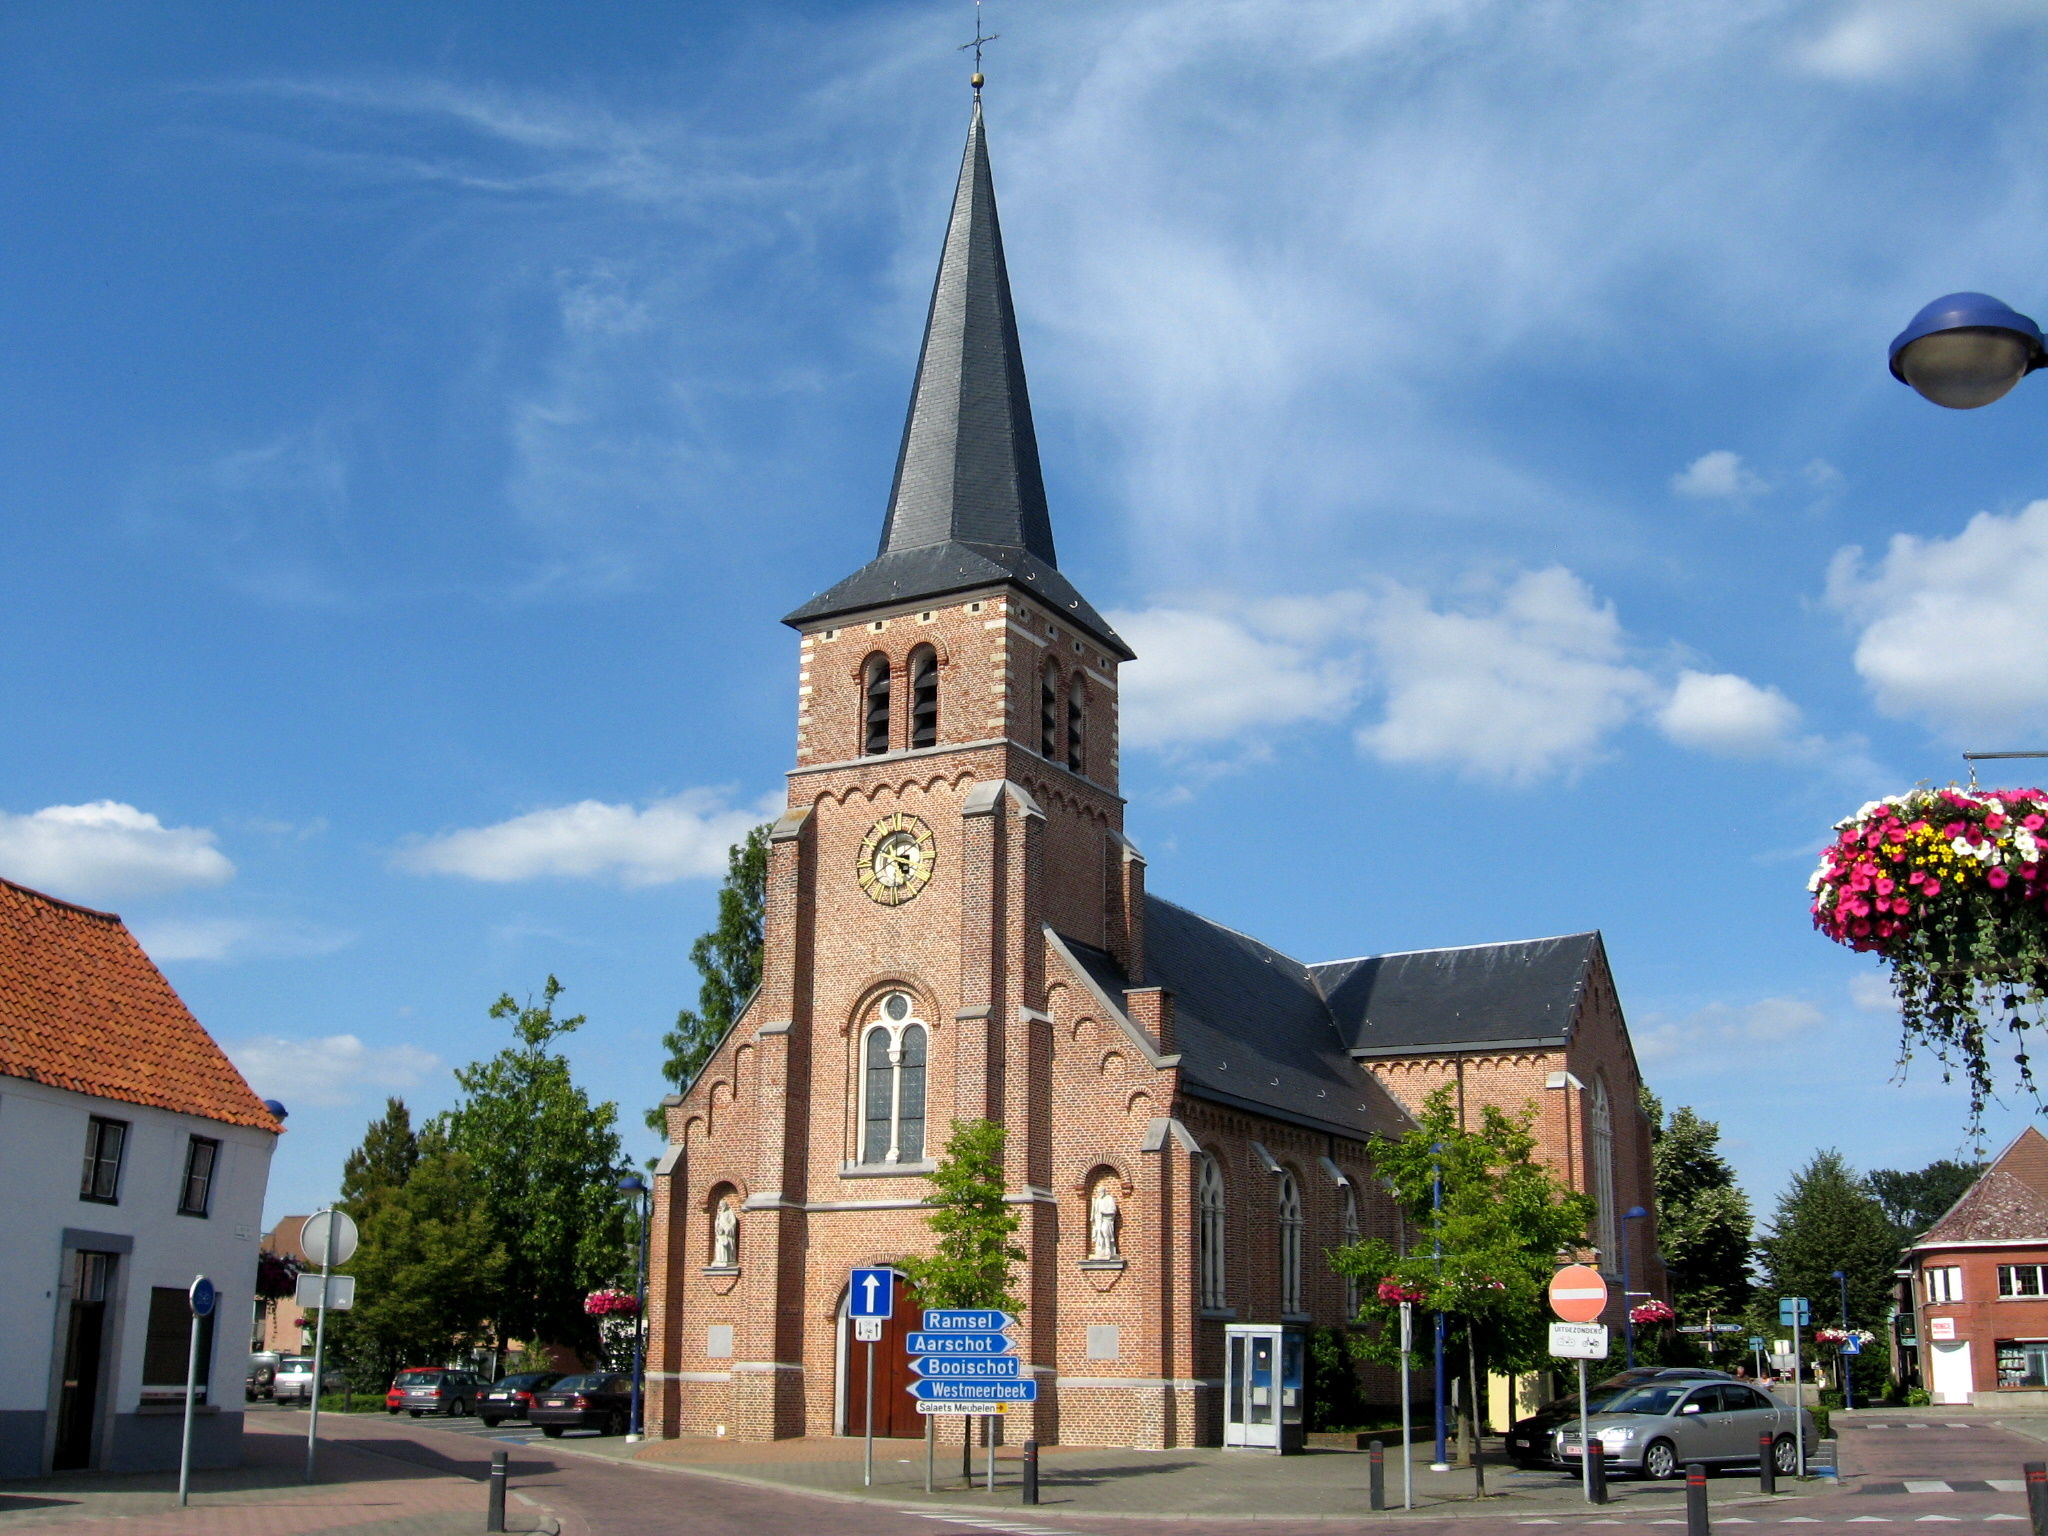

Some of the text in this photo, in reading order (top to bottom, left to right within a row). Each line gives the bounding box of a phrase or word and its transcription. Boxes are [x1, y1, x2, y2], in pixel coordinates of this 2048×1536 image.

[929, 1313, 992, 1328] Ramsel
[1554, 1326, 1603, 1335] UITGEZONDERD
[914, 1336, 993, 1351] Aarschot
[928, 1359, 1015, 1375] Booischot
[931, 1382, 1027, 1398] Westmeerbeek
[919, 1403, 996, 1412] Salaets Meubelen
